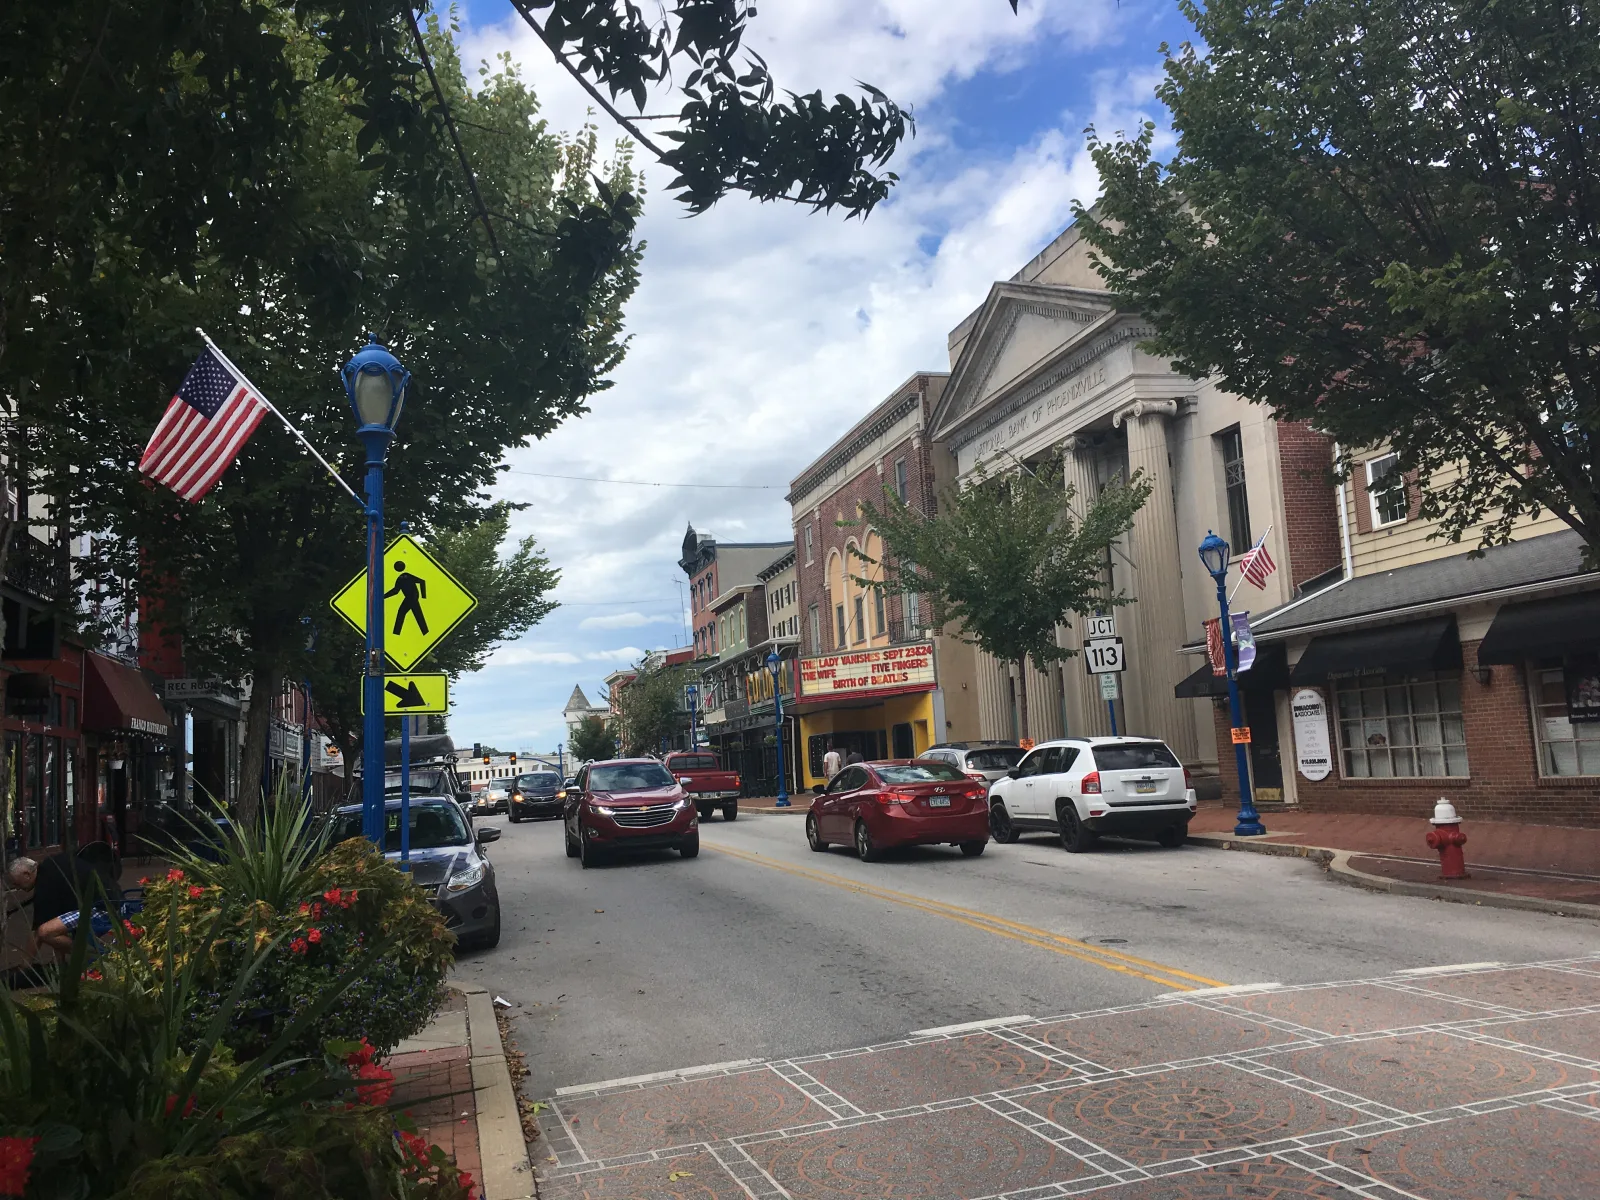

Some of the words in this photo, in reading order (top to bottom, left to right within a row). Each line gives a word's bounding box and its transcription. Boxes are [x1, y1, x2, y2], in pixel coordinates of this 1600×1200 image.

[974, 431, 1005, 458] NATIONAL
[1008, 415, 1029, 438] BANK
[1032, 405, 1043, 424] OF
[1046, 367, 1106, 416] PHOENIXVILLE
[1090, 618, 1113, 636] JCT
[801, 659, 817, 671] THE
[818, 657, 839, 669] LADY
[841, 652, 881, 665] VANISHES
[883, 648, 903, 660] SEPT
[905, 645, 933, 657] 23&24
[1091, 646, 1118, 667] 113
[802, 670, 817, 681] THE
[817, 668, 836, 680] WIFE
[871, 663, 890, 674] FIVE
[891, 658, 928, 671] FINGERS
[168, 682, 186, 691] REC
[832, 677, 856, 690] BIRTH
[857, 676, 869, 687] OF
[871, 672, 909, 686] BEATLES
